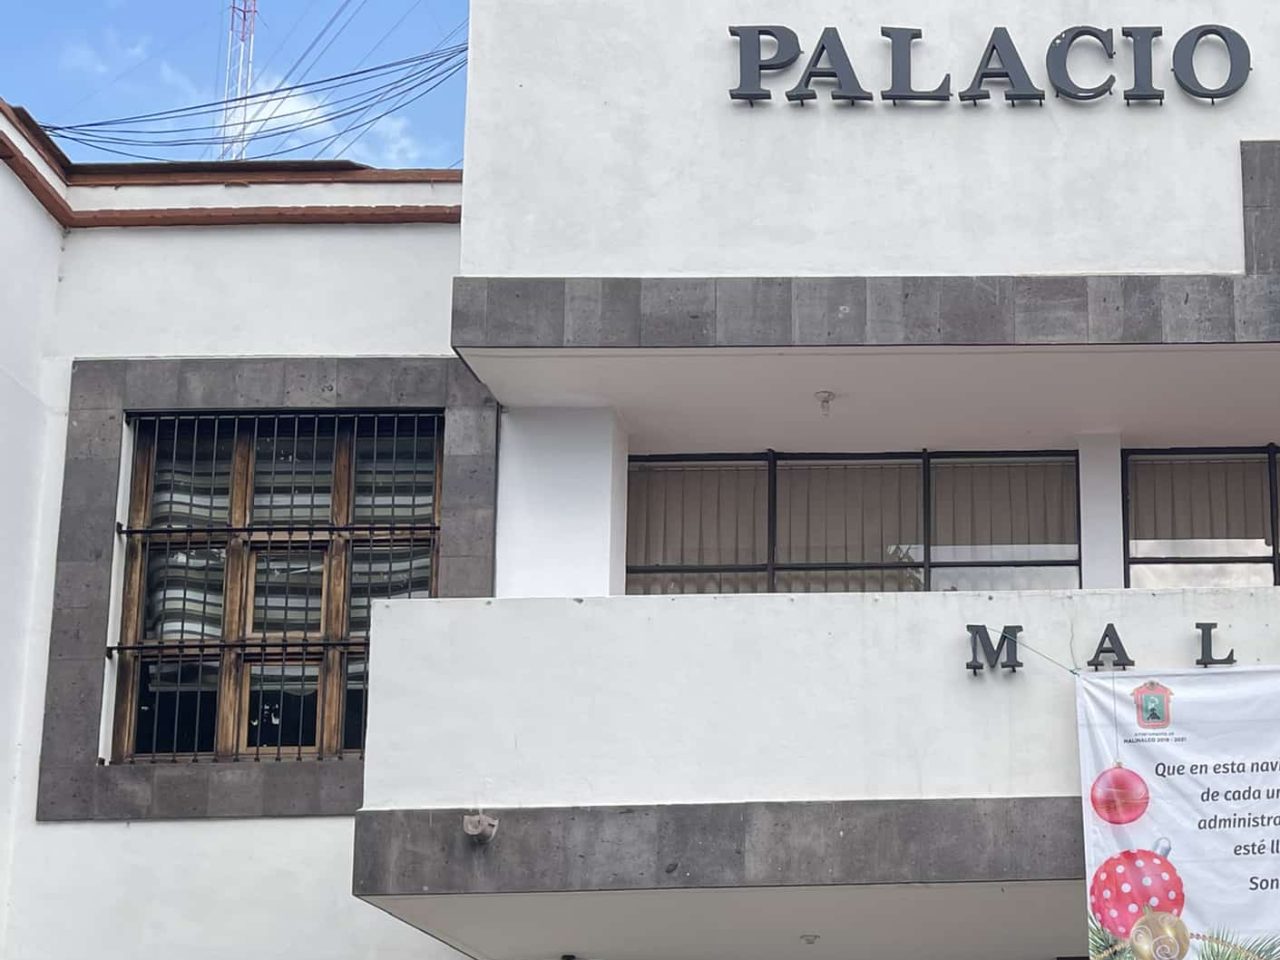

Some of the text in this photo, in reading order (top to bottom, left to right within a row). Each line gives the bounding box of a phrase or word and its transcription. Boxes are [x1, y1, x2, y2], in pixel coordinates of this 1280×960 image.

[728, 24, 1252, 100] PALACIO
[1155, 762, 1185, 777] Que
[1190, 762, 1208, 774] en
[1213, 760, 1246, 774] esta
[1201, 787, 1220, 802] de
[1224, 786, 1261, 801] cada
[1233, 839, 1266, 855] esté
[1249, 875, 1279, 891] Son
